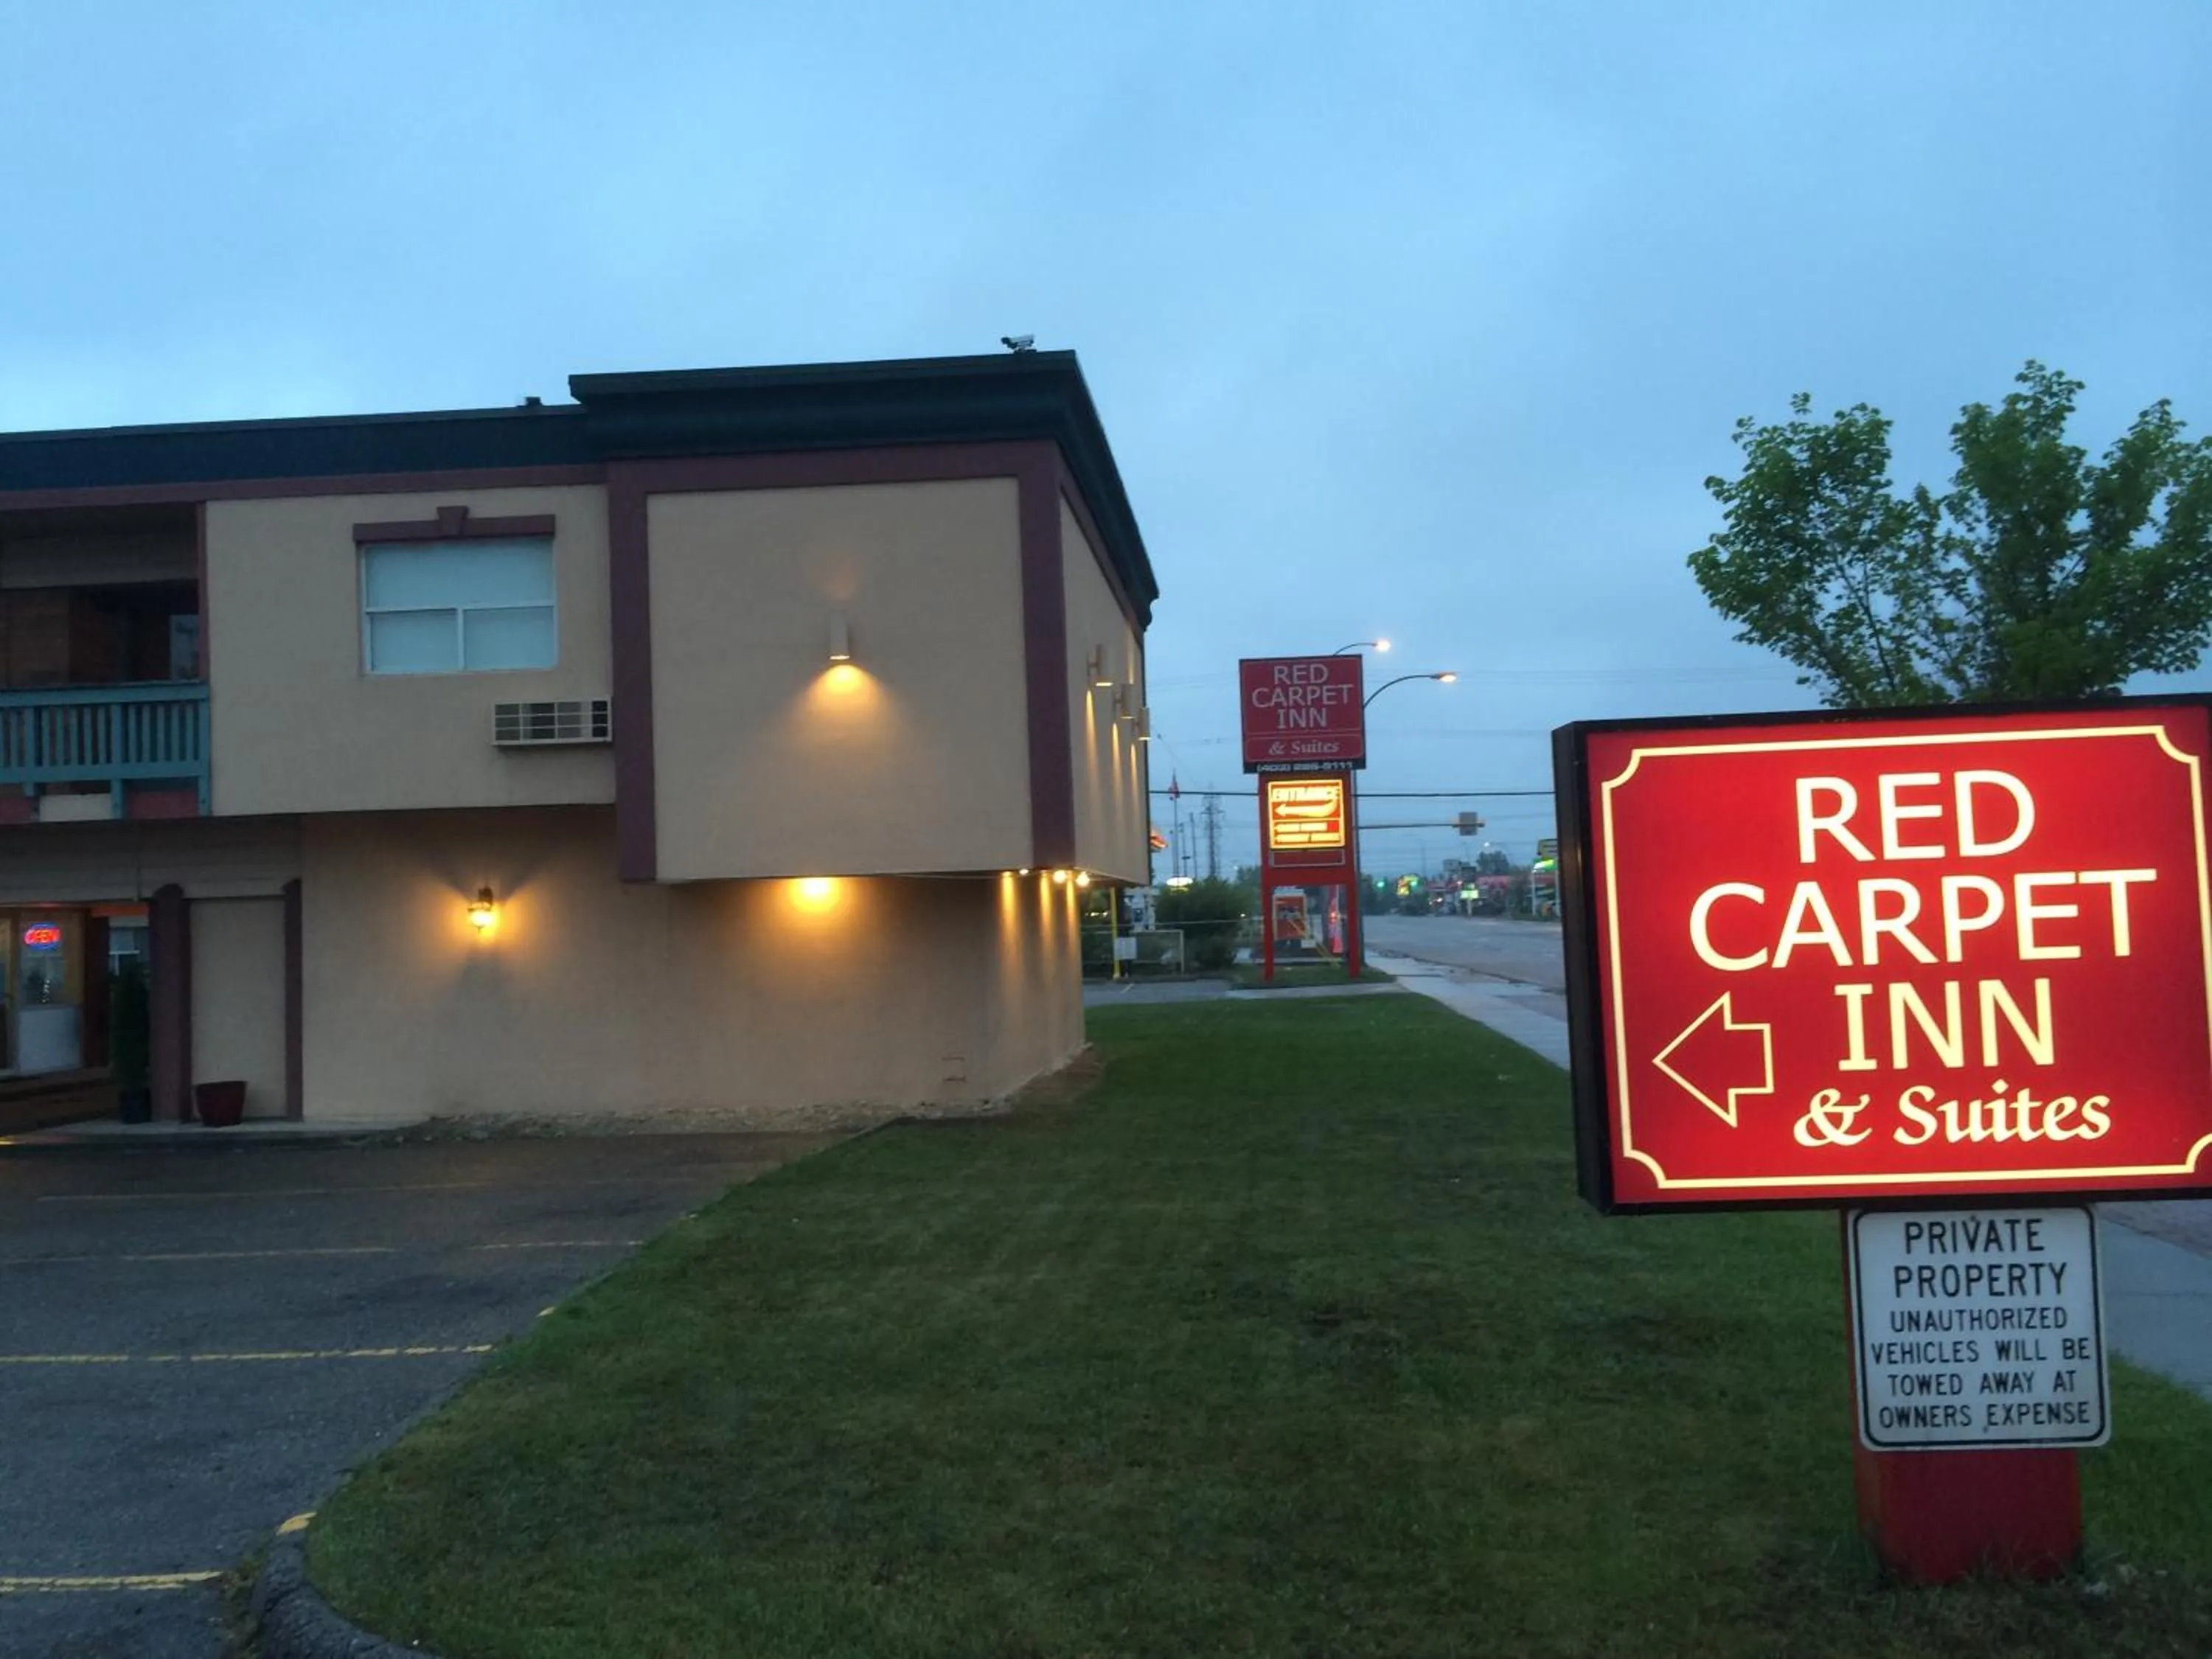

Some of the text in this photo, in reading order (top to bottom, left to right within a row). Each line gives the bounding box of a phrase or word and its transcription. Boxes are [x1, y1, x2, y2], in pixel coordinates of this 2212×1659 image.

[1273, 664, 1329, 685] RED
[1252, 684, 1354, 708] CARPET
[1276, 707, 1327, 729] INN
[1269, 739, 1339, 755] & Suites
[1795, 770, 2036, 864] RED
[1689, 869, 2157, 972] CARPET
[1834, 978, 2055, 1071] INN
[1793, 1079, 2111, 1147] & Suites
[1905, 1218, 2045, 1254] PRIVATE
[1893, 1262, 2067, 1298] PROPERTY
[1890, 1307, 2068, 1332] UNAUTHORIZED
[1871, 1337, 2091, 1365] VEHICLES WILL BE
[1888, 1369, 2078, 1396] TOWED AWAY AT
[1879, 1401, 2090, 1429] OWNERS EXPENSE
